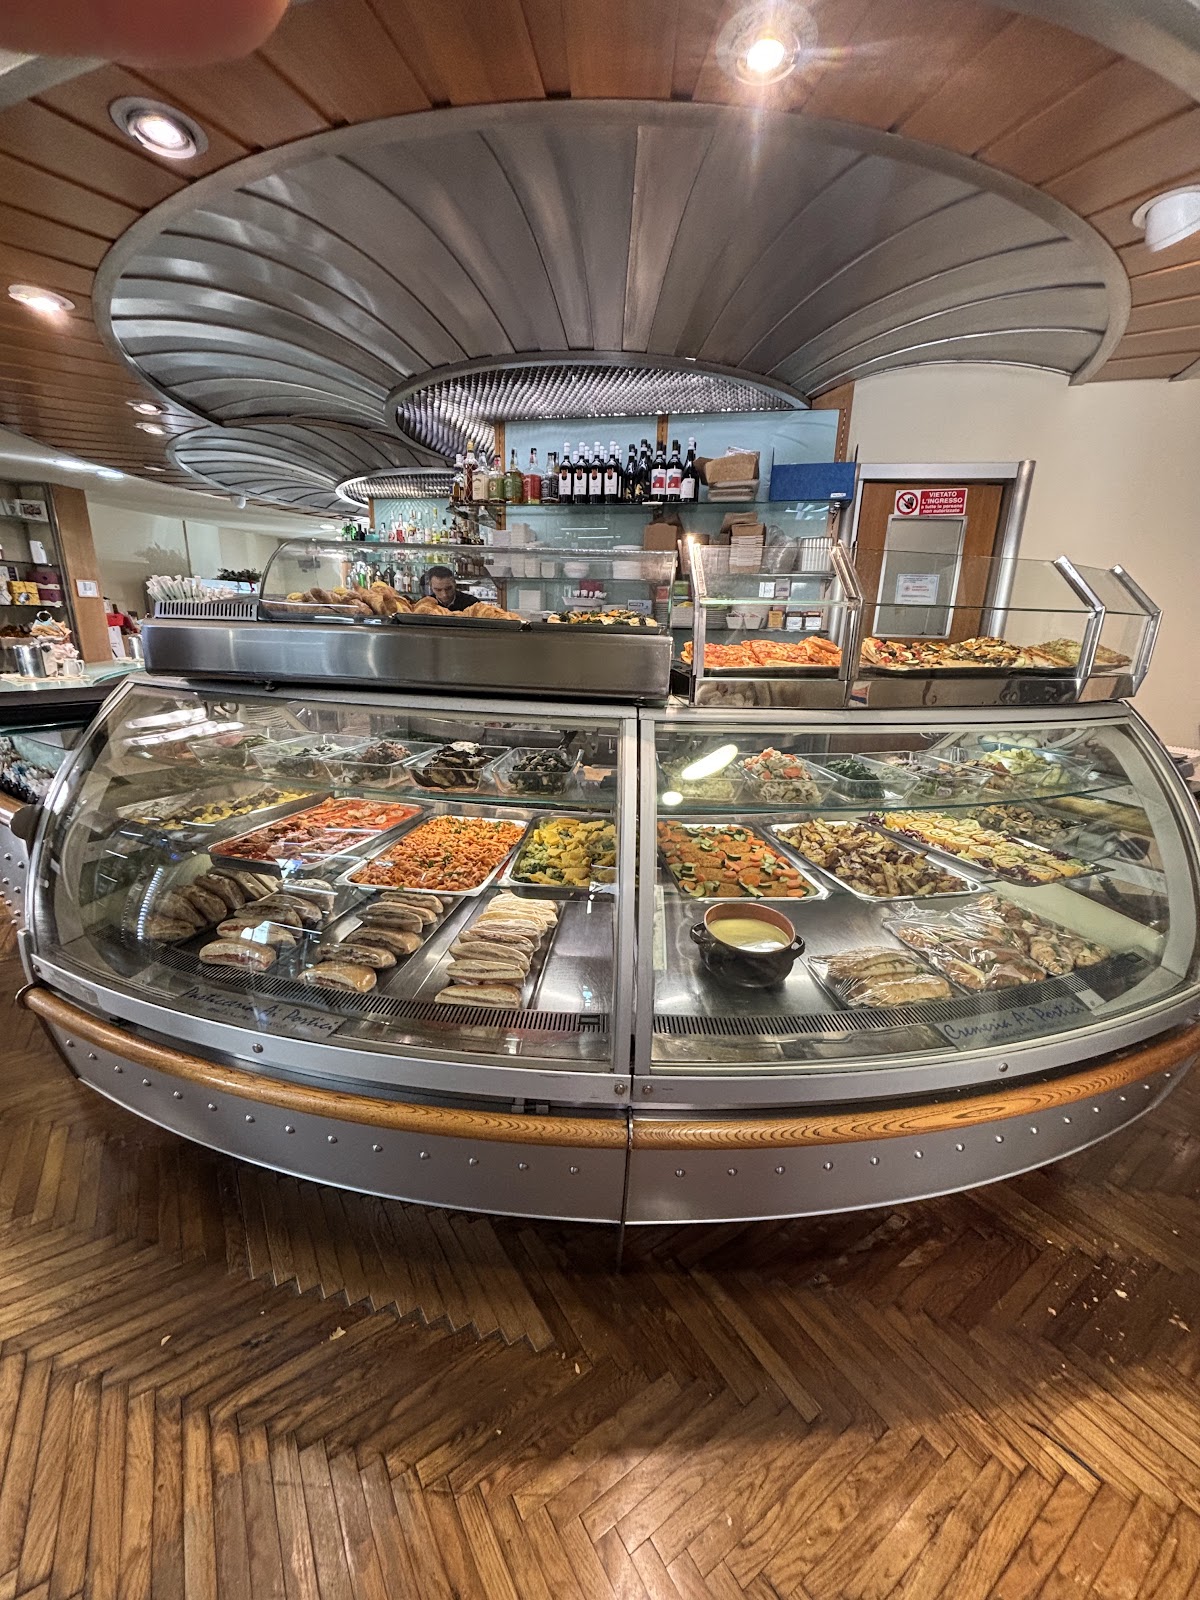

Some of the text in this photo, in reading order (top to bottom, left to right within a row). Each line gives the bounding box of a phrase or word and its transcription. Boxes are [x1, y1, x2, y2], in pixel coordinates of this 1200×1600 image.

[282, 1008, 338, 1031] Portici
[943, 1018, 1013, 1040] Cremeria
[1028, 1002, 1085, 1021] Portici
